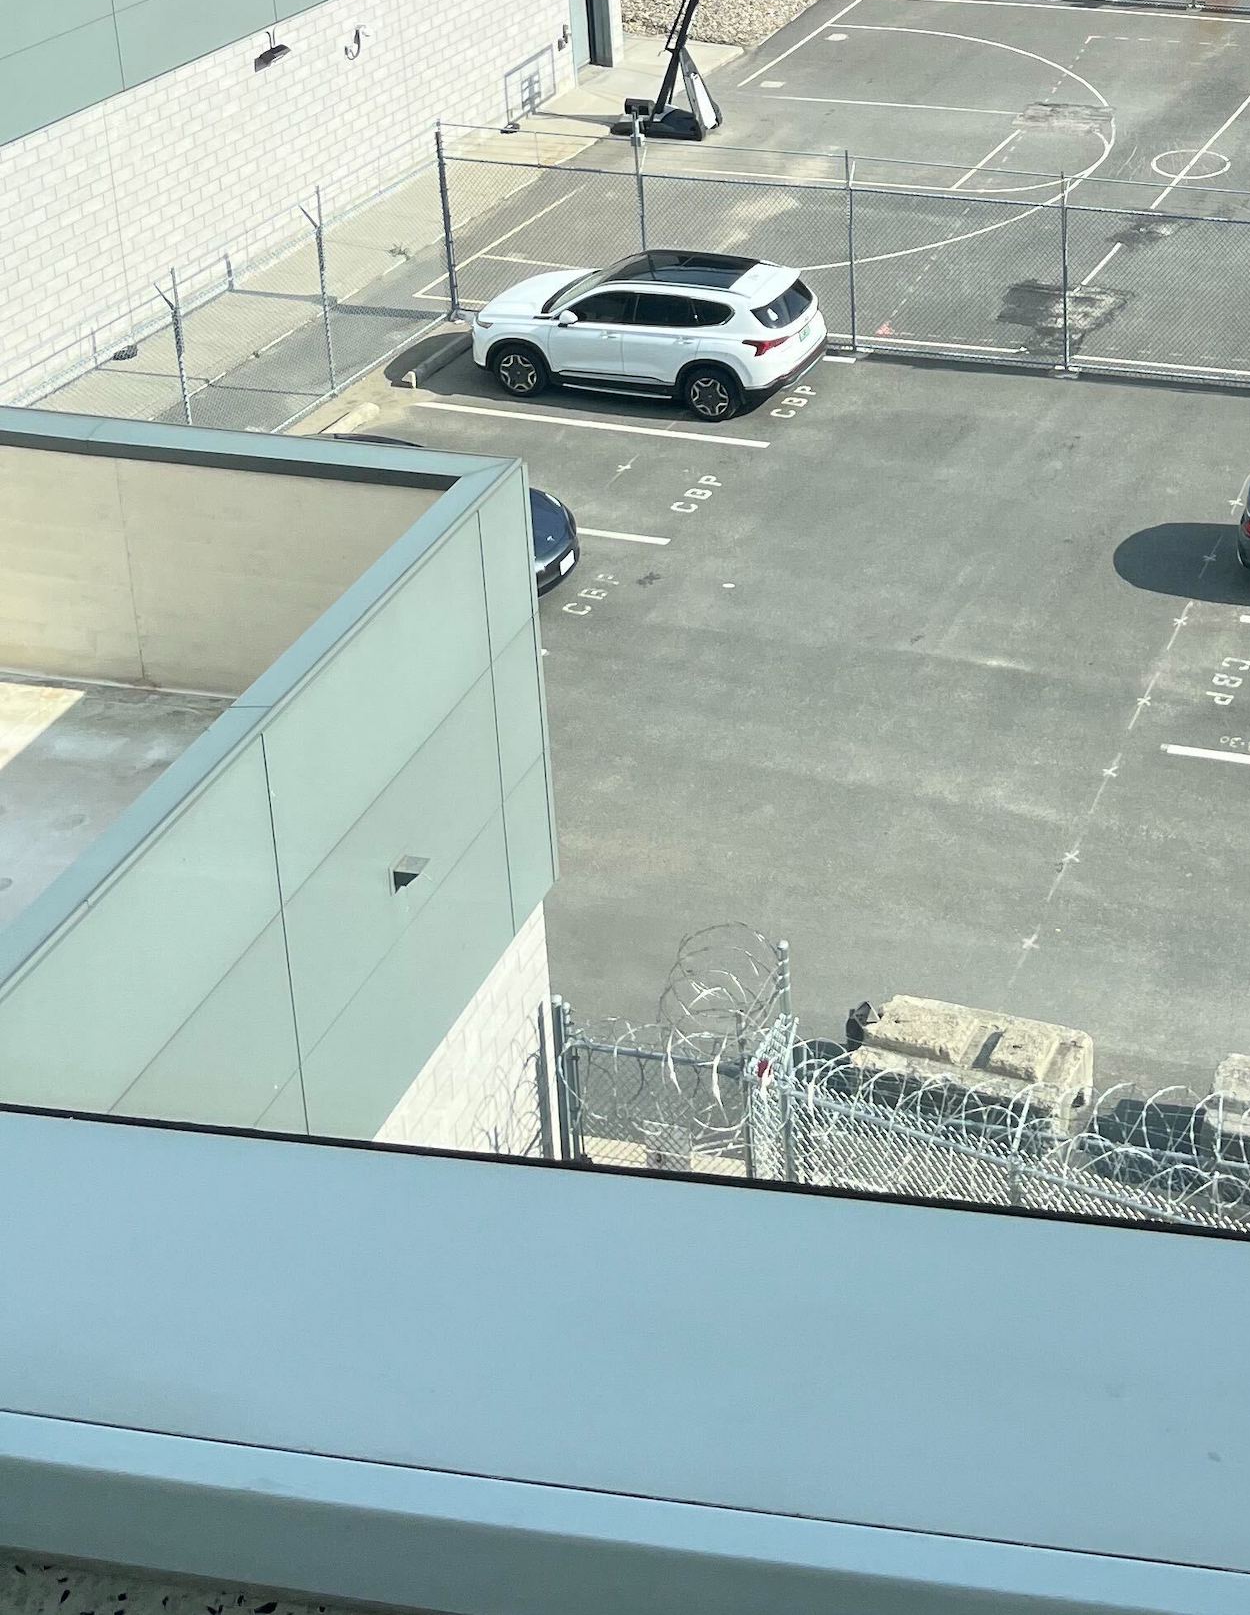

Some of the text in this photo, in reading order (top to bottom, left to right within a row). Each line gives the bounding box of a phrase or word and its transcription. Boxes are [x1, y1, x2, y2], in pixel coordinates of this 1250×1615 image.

[770, 384, 817, 420] CBP
[670, 474, 722, 514] CBP
[562, 573, 620, 616] CBP
